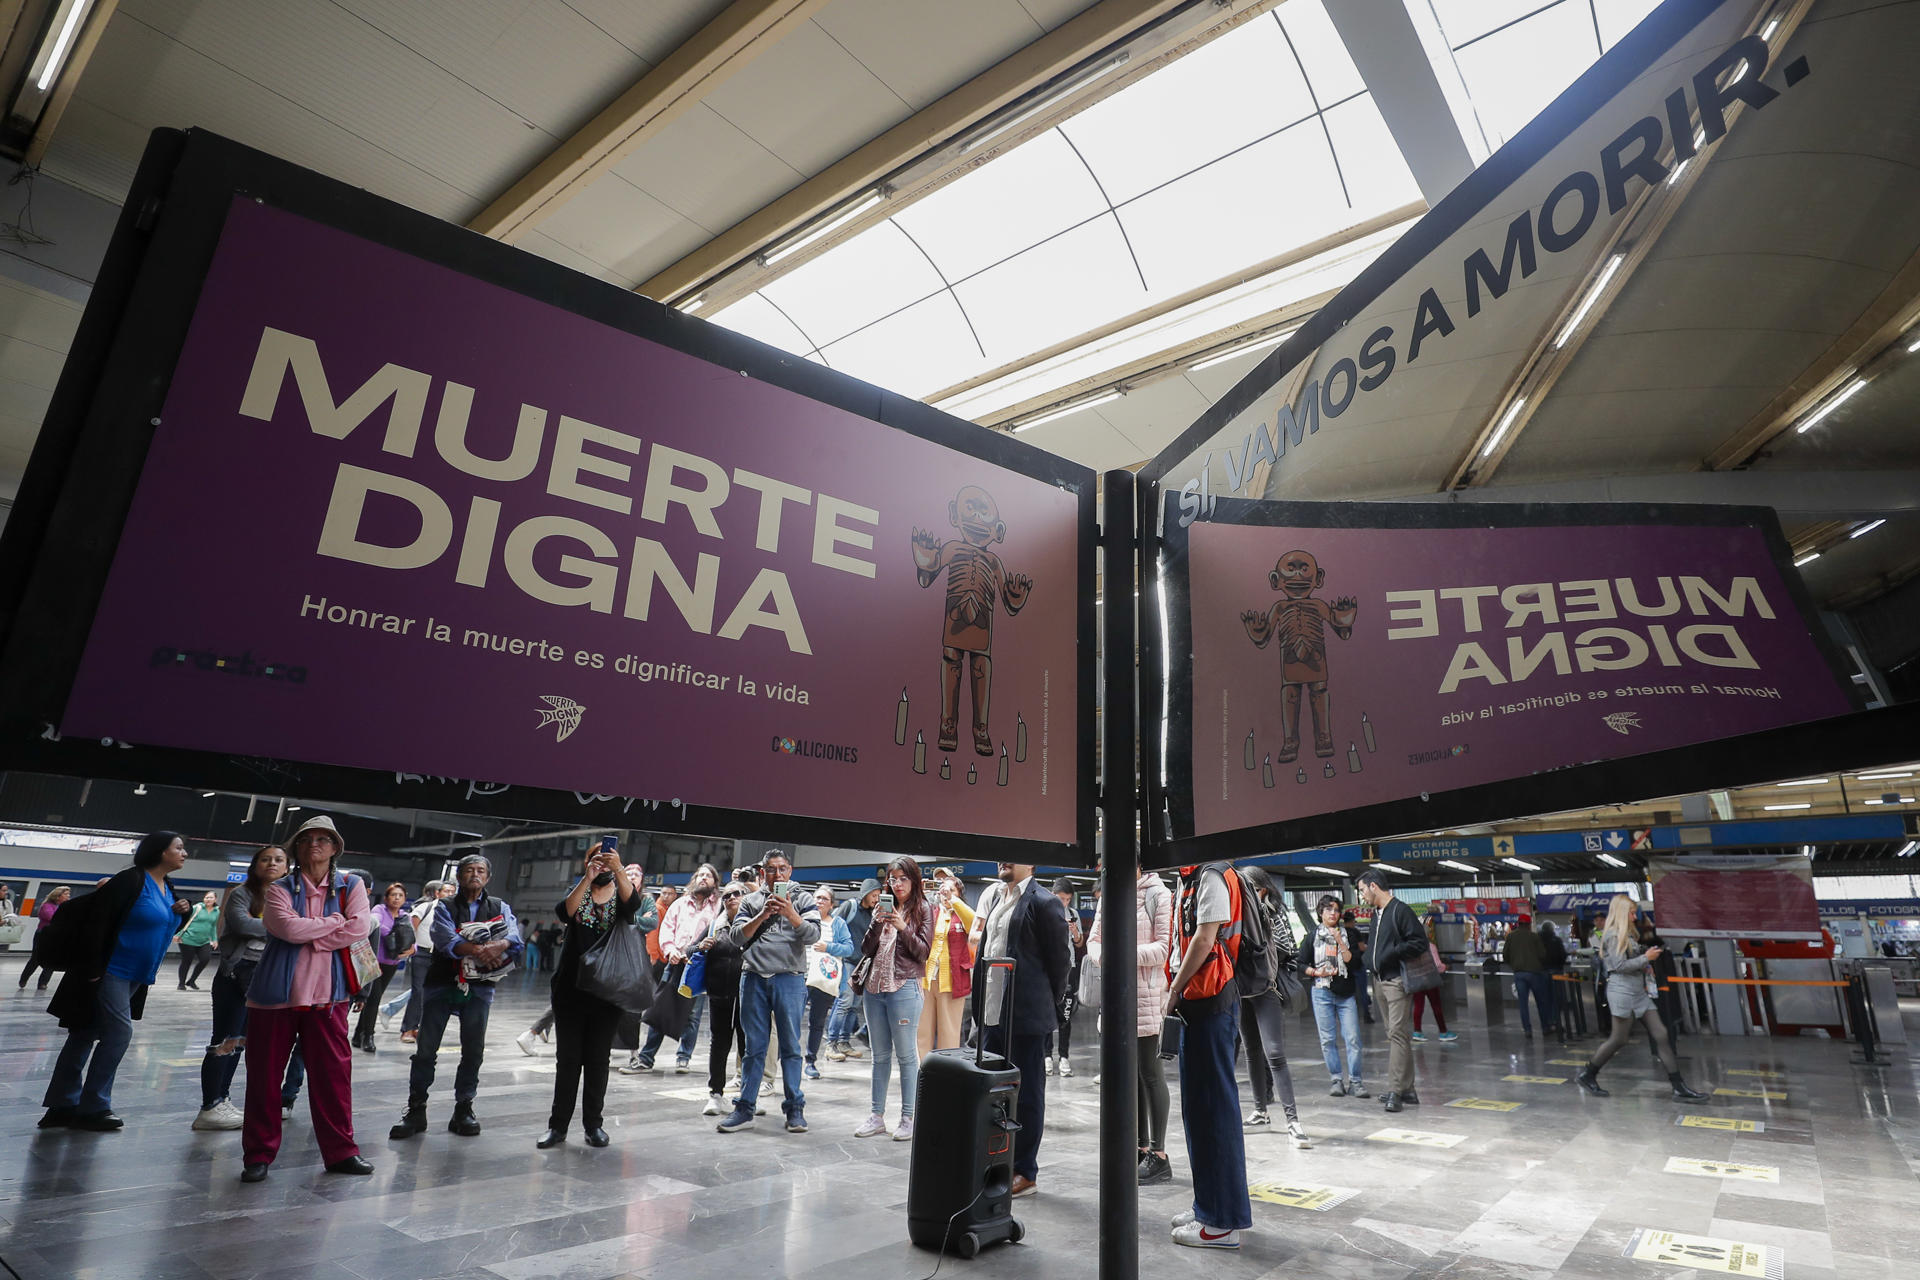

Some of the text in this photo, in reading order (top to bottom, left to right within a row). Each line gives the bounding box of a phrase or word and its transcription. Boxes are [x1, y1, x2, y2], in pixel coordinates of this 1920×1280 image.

[1223, 326, 1396, 492] VAMOS
[1407, 287, 1455, 363] A
[1464, 34, 1811, 319] MORIR.
[238, 325, 880, 580] MUERTE
[316, 462, 814, 656] DIGNA
[300, 594, 811, 706] Honrar la muerte es dignificar la vida
[544, 696, 576, 709] MUERTE
[542, 707, 580, 722] DIGNA
[559, 718, 577, 738] YA!
[1402, 847, 1470, 859] HOMBRES
[1411, 840, 1459, 849] ENTRADA
[1818, 905, 1920, 915] CULOS FOTOGR
